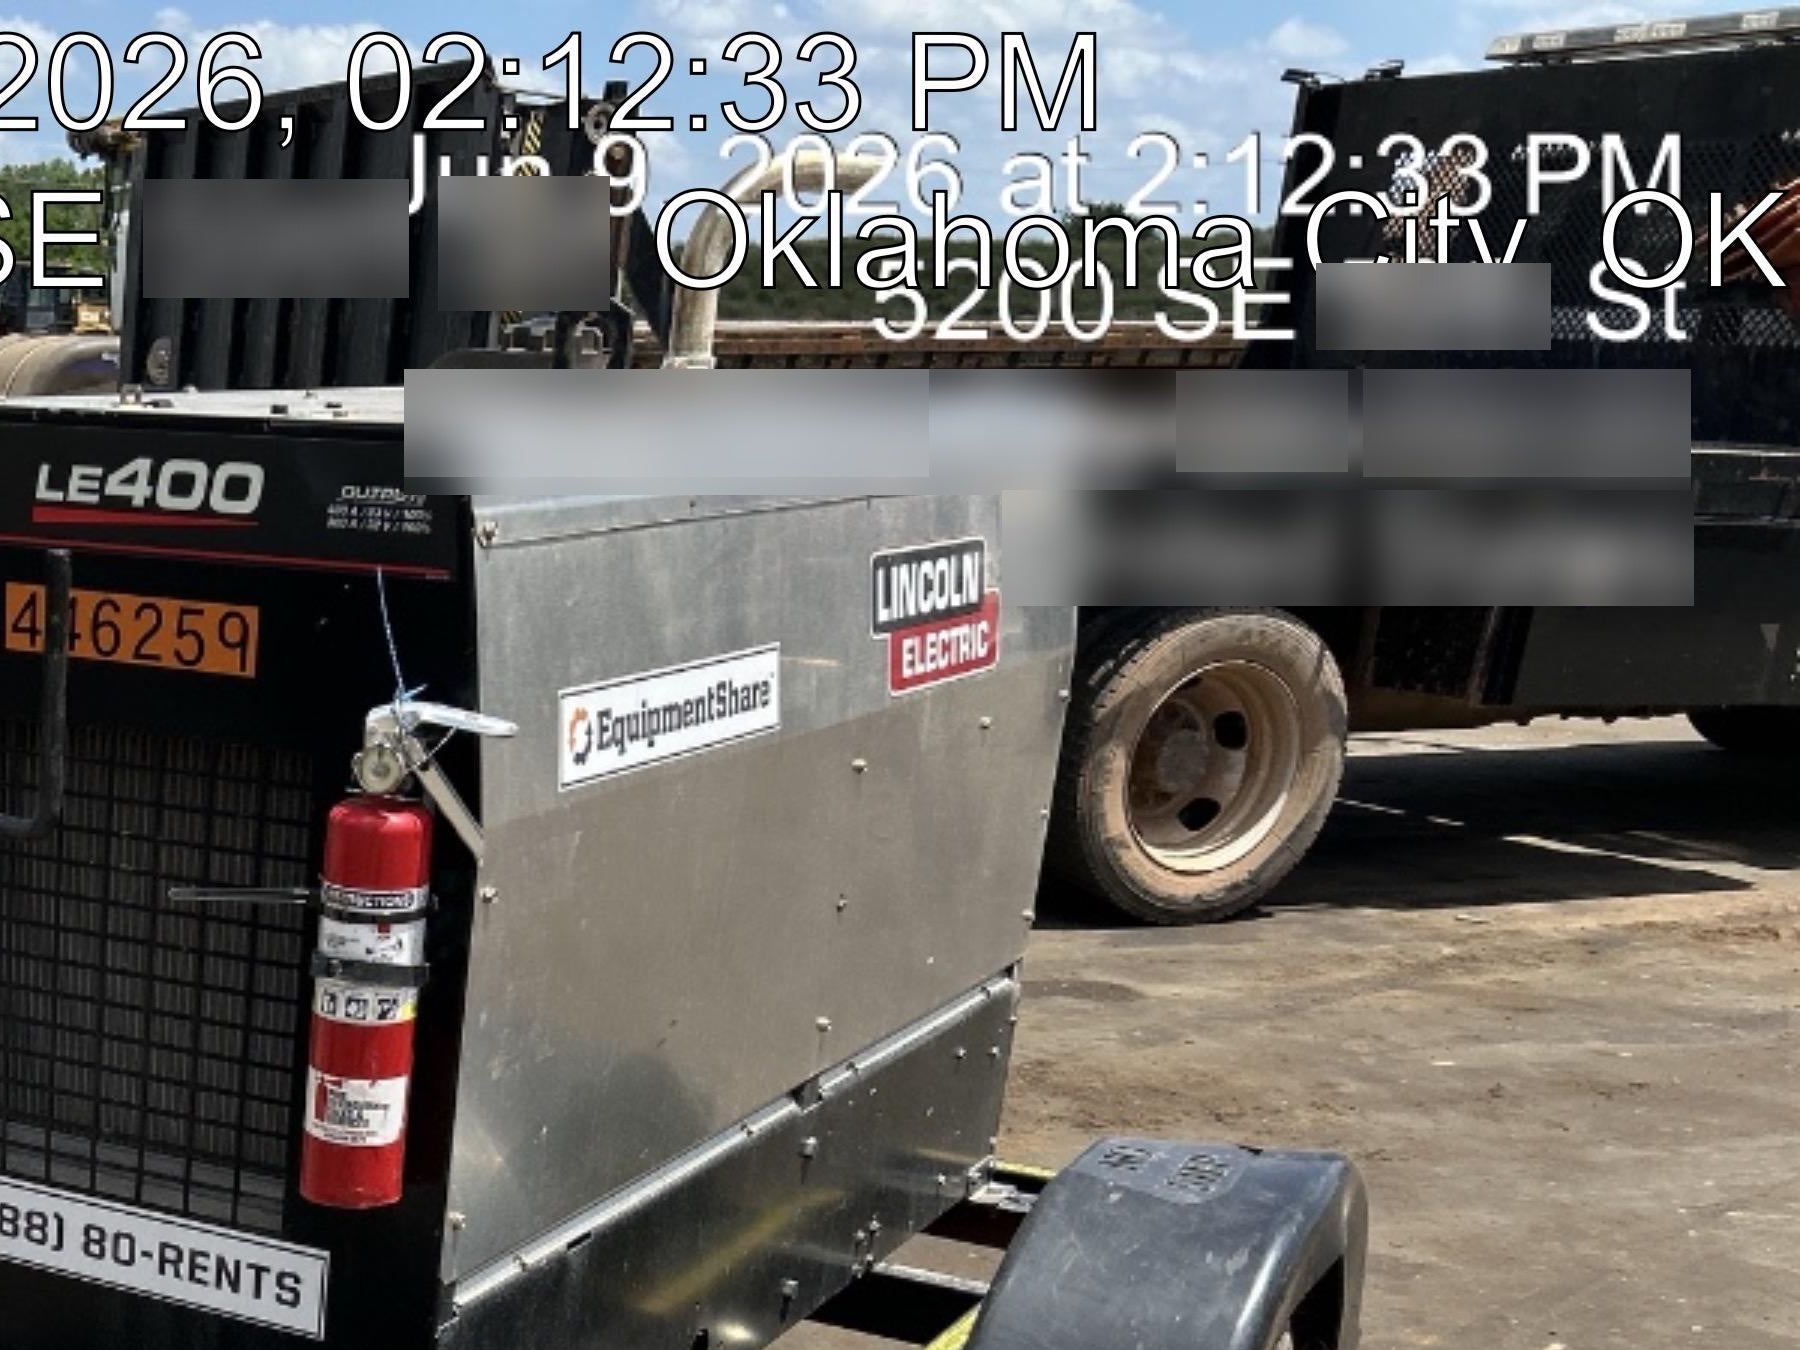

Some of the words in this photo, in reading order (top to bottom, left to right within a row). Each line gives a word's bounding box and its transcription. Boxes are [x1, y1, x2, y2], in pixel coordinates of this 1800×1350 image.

[35, 457, 265, 514] LE400
[877, 551, 980, 624] LINCOLN
[903, 620, 991, 679] ELECTRIC
[597, 677, 771, 756] EquipmentShare
[82, 1222, 302, 1309] 80-RENTS
